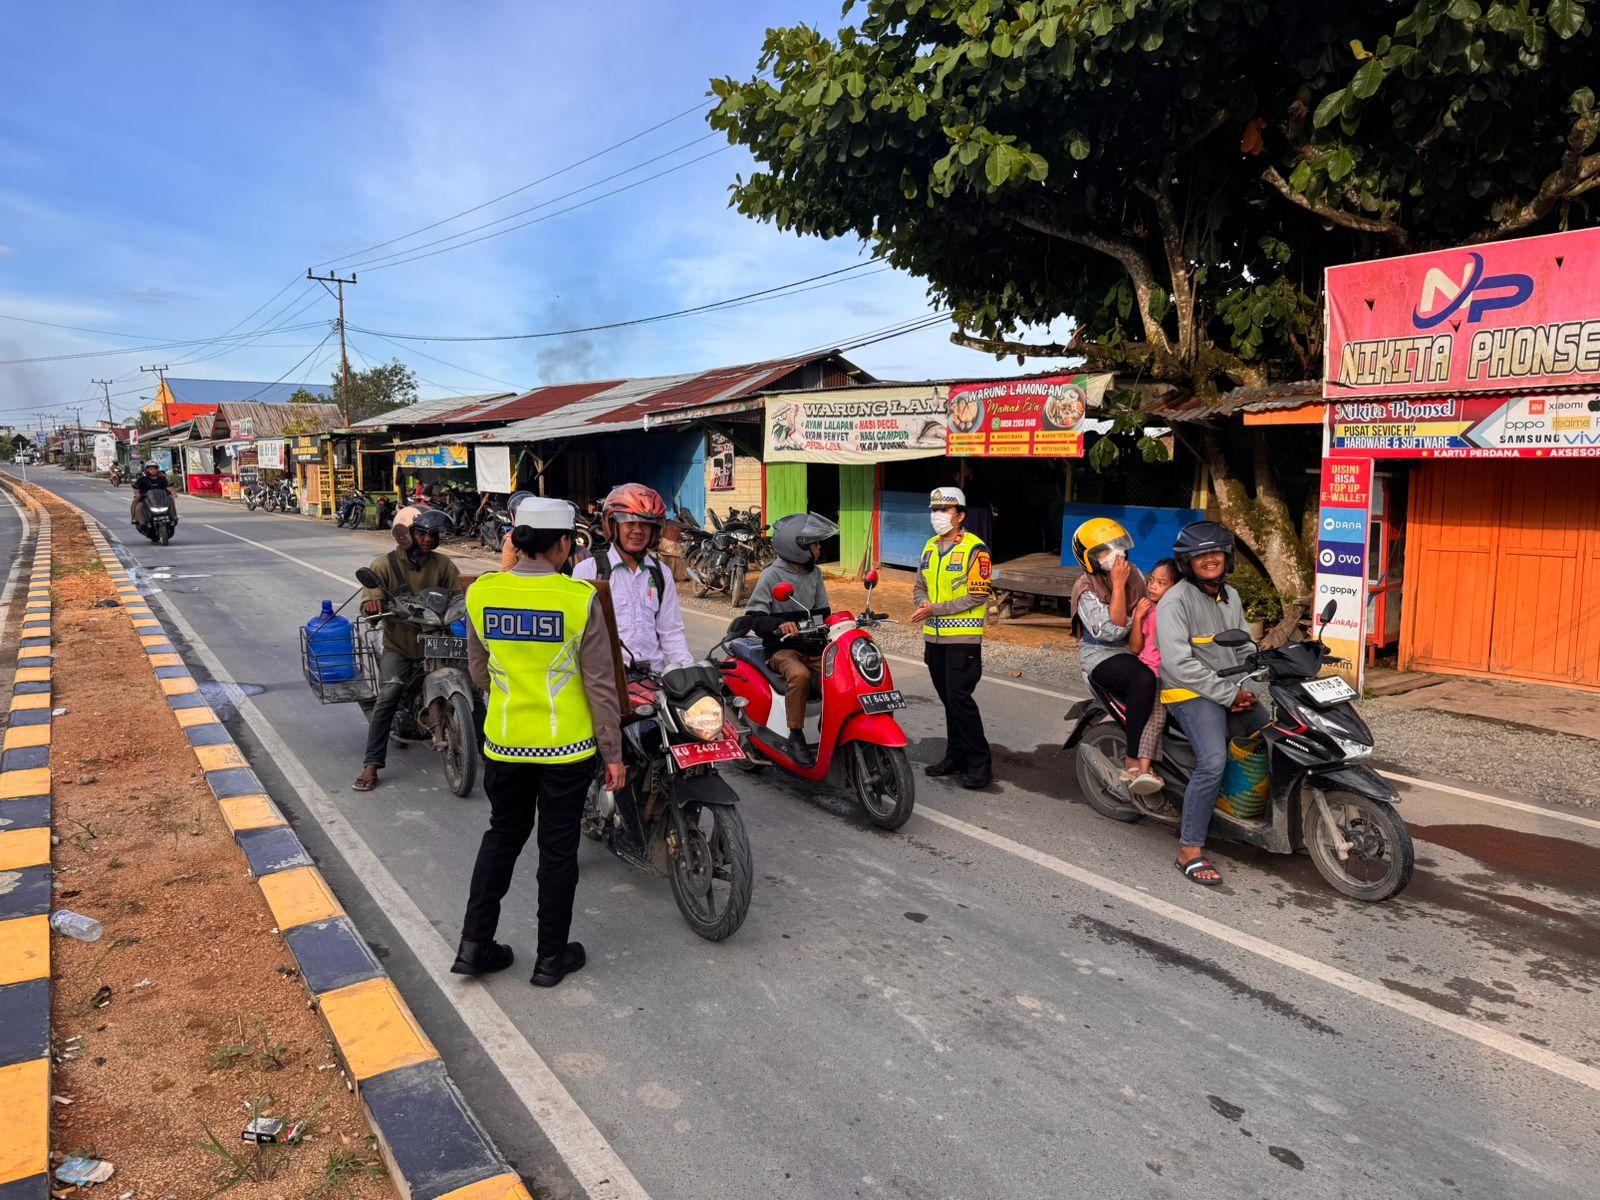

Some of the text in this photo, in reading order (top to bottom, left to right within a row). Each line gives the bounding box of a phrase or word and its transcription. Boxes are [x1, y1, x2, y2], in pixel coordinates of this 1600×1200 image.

[1338, 334, 1453, 388] NIKITA
[968, 384, 1062, 401] WARUNG LAMONGAN
[803, 402, 887, 417] WARUNG
[1335, 398, 1456, 422] Nikita Phonsel
[1549, 402, 1583, 410] xiaomi
[805, 420, 854, 430] AYAM LALAPAN
[859, 419, 899, 430] NASI PECEL
[1505, 420, 1545, 431] oppo
[1552, 418, 1590, 428] realme
[1344, 425, 1369, 437] PUSAT
[1372, 425, 1402, 437] SEVICE
[1345, 436, 1450, 448] HARDWARE & SOFTWARE
[1499, 434, 1560, 444] SAMSUNG
[1434, 449, 1520, 458] KARTU PERDANA
[1332, 465, 1359, 474] DISINI
[1334, 474, 1355, 483] BISA
[1329, 483, 1360, 493] TOP UP
[1322, 492, 1367, 503] E-WALLET
[1335, 521, 1362, 529] DANA
[1338, 554, 1360, 564] OVO
[1330, 586, 1357, 596] gopay
[485, 613, 560, 637] POLISI
[427, 639, 437, 647] KU
[862, 695, 872, 704] KT
[673, 746, 689, 757] KU
[694, 743, 720, 753] 2402
[1286, 738, 1309, 752] HONDA
